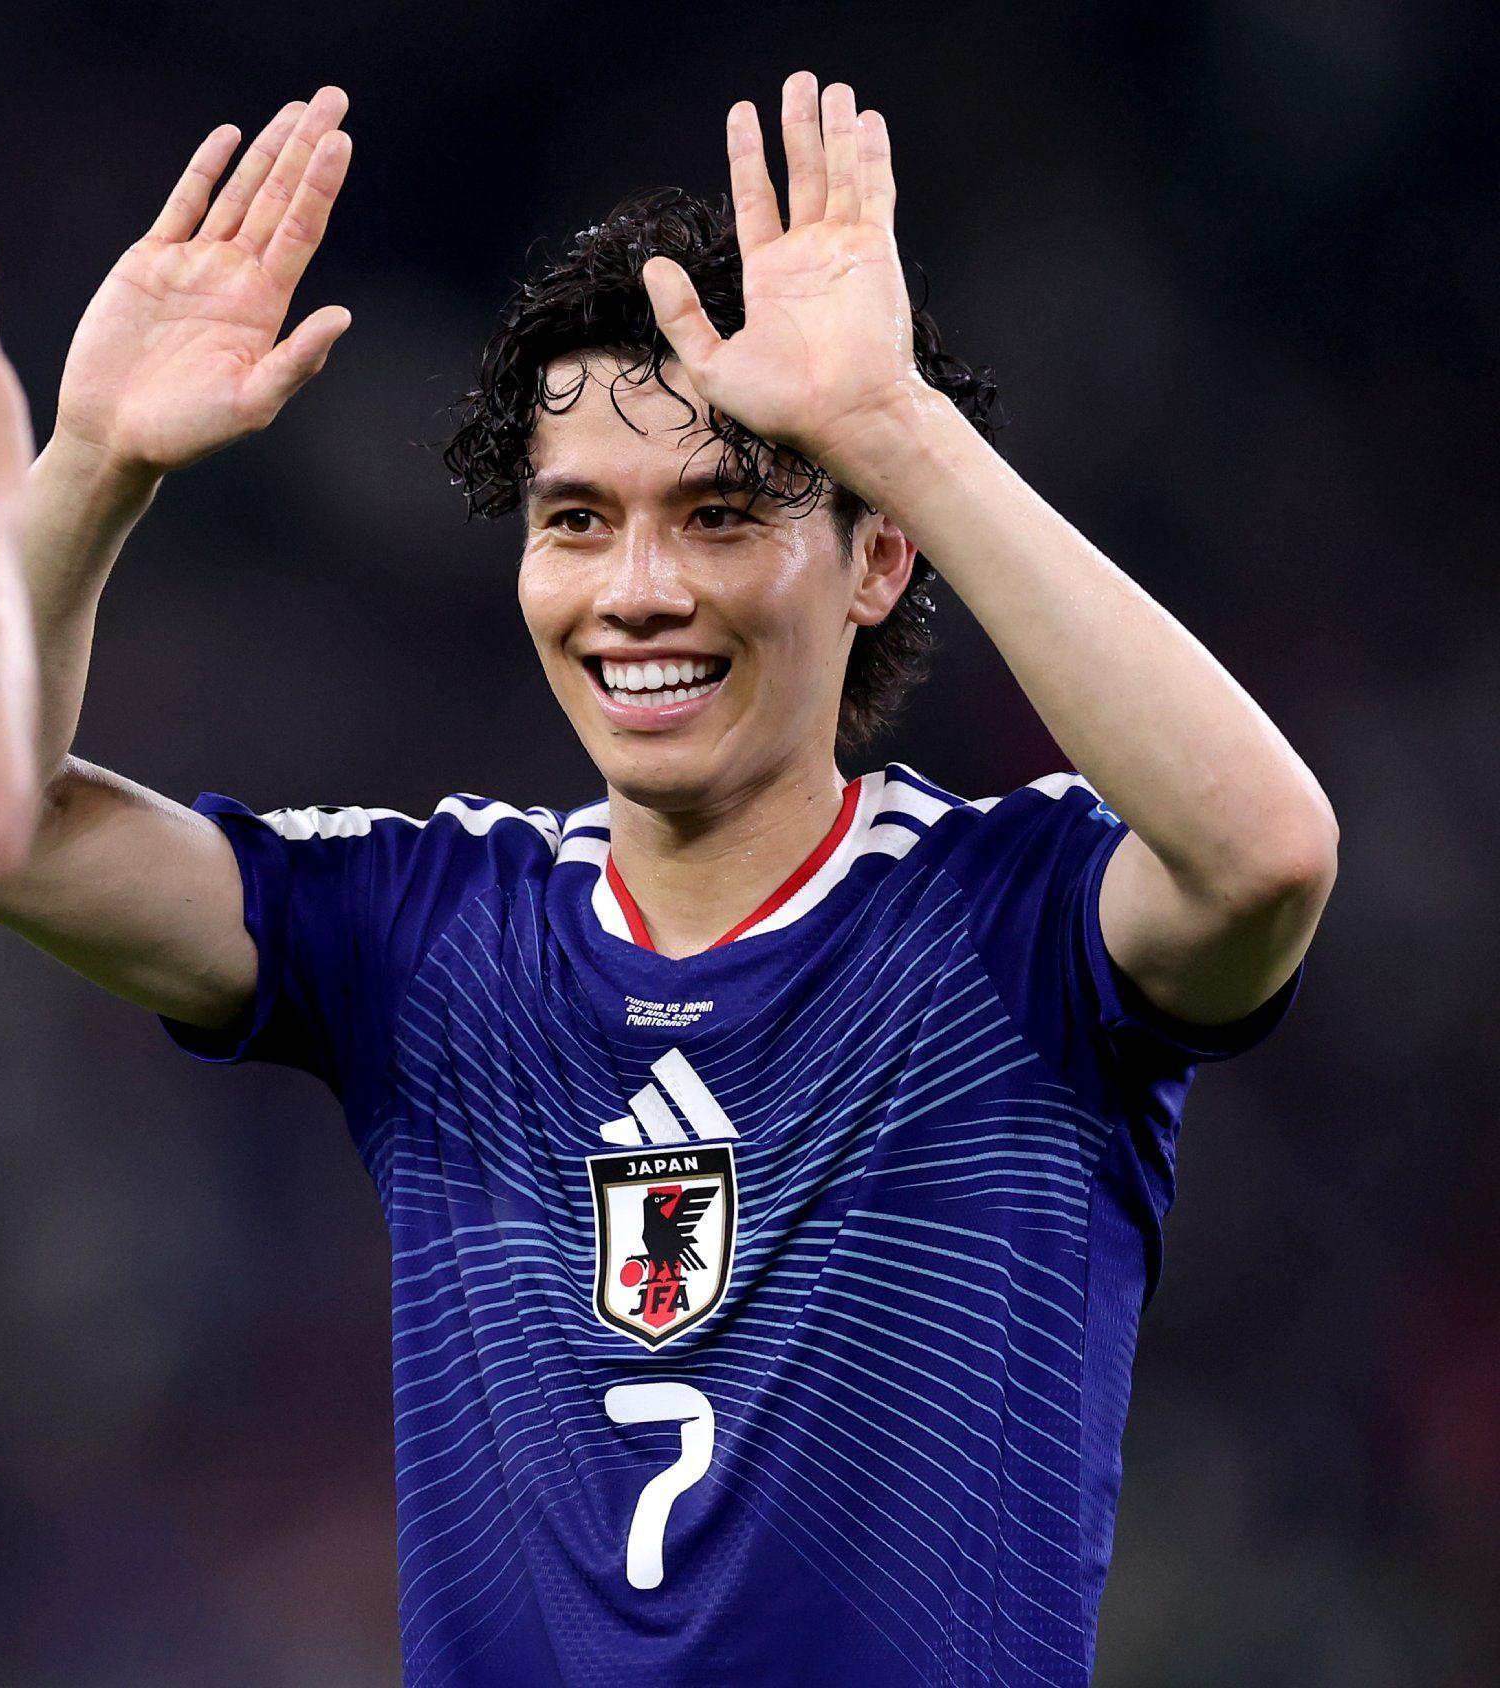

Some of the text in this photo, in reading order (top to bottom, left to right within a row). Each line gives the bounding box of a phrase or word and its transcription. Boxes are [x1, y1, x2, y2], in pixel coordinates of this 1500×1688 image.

[624, 995, 665, 1011] TUNISIA
[681, 1000, 714, 1013] JAPAN
[626, 1004, 702, 1022] 20 JUNE 2026
[626, 1014, 691, 1027] MONTERREY
[626, 1156, 699, 1177] JAPAN
[628, 1284, 691, 1316] JFA
[604, 1382, 715, 1590] 7
